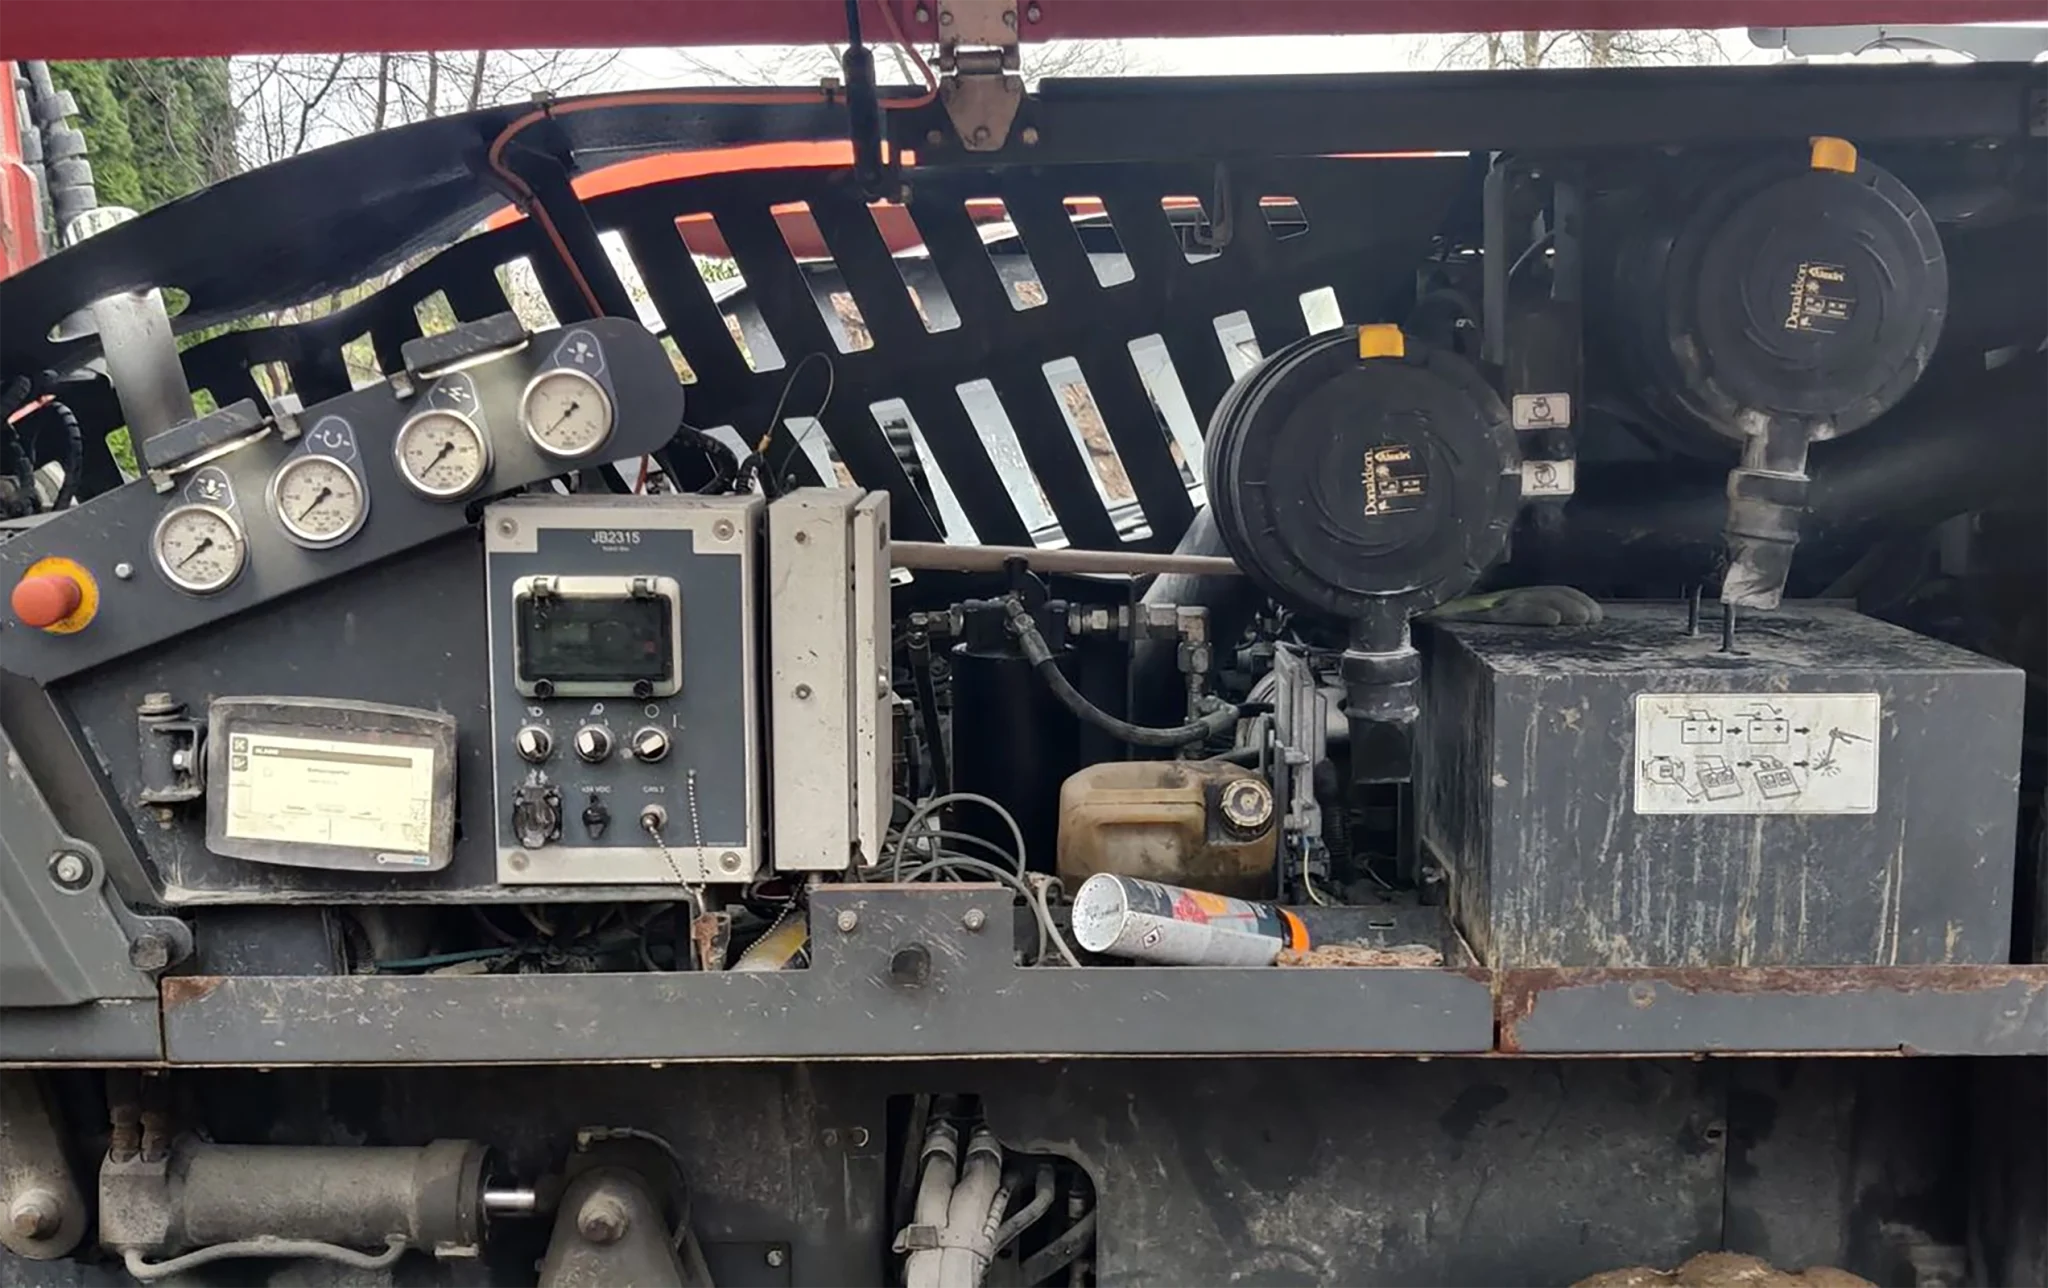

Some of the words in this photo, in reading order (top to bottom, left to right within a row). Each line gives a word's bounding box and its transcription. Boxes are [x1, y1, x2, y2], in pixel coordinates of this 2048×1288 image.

[1785, 261, 1808, 329] Donaldson
[1361, 448, 1378, 516] Donaldson
[591, 530, 641, 544] JB2315
